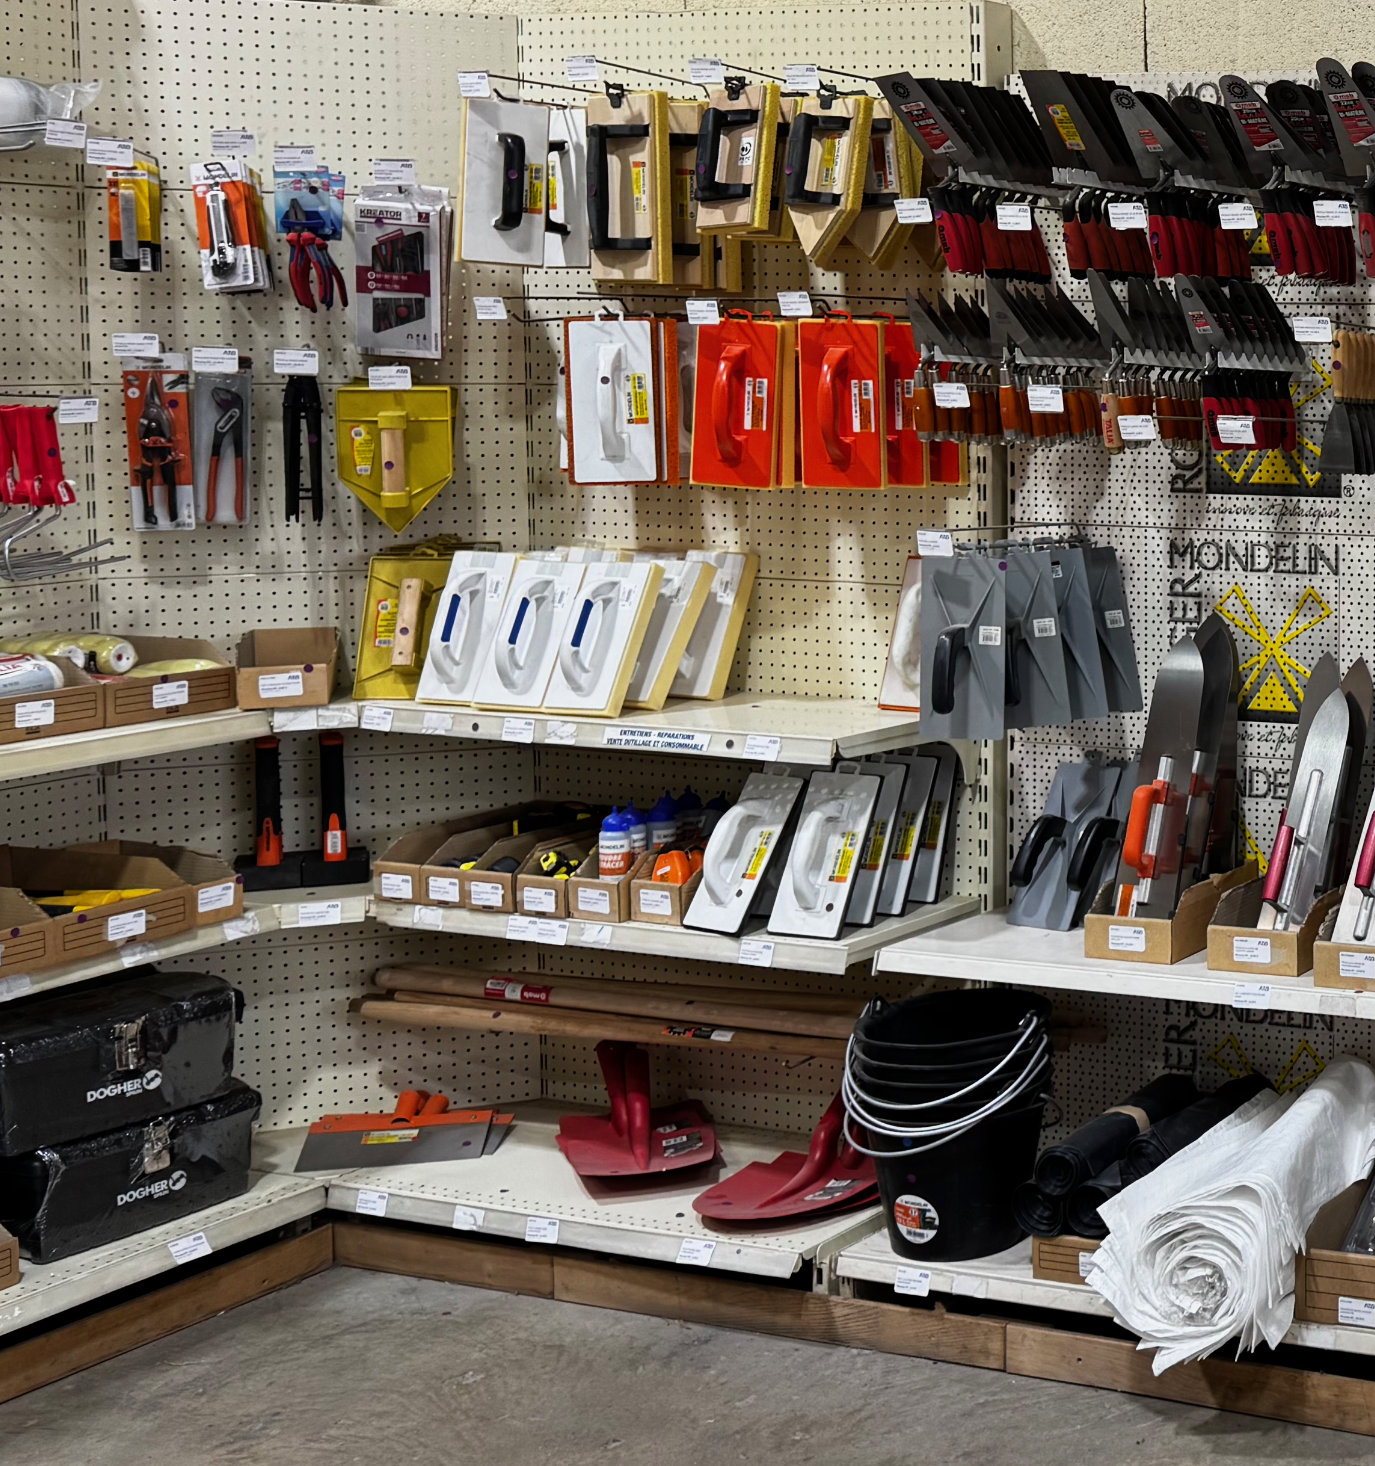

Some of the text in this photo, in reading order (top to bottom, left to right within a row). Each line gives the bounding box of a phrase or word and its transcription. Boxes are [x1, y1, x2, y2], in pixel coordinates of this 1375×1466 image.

[359, 208, 402, 218] KREATOR
[1103, 418, 1115, 444] TALIA
[1258, 503, 1276, 517] et
[1168, 537, 1341, 577] MONDELIN
[620, 729, 652, 738] ENTRETIENS
[657, 732, 696, 742] REPARATIONS
[607, 738, 622, 746] VENTE
[660, 741, 704, 751] CONSOMMABLE
[87, 1078, 142, 1103] DOGHER
[117, 1179, 168, 1206] DOGHER
[153, 1189, 169, 1199] SPAIN
